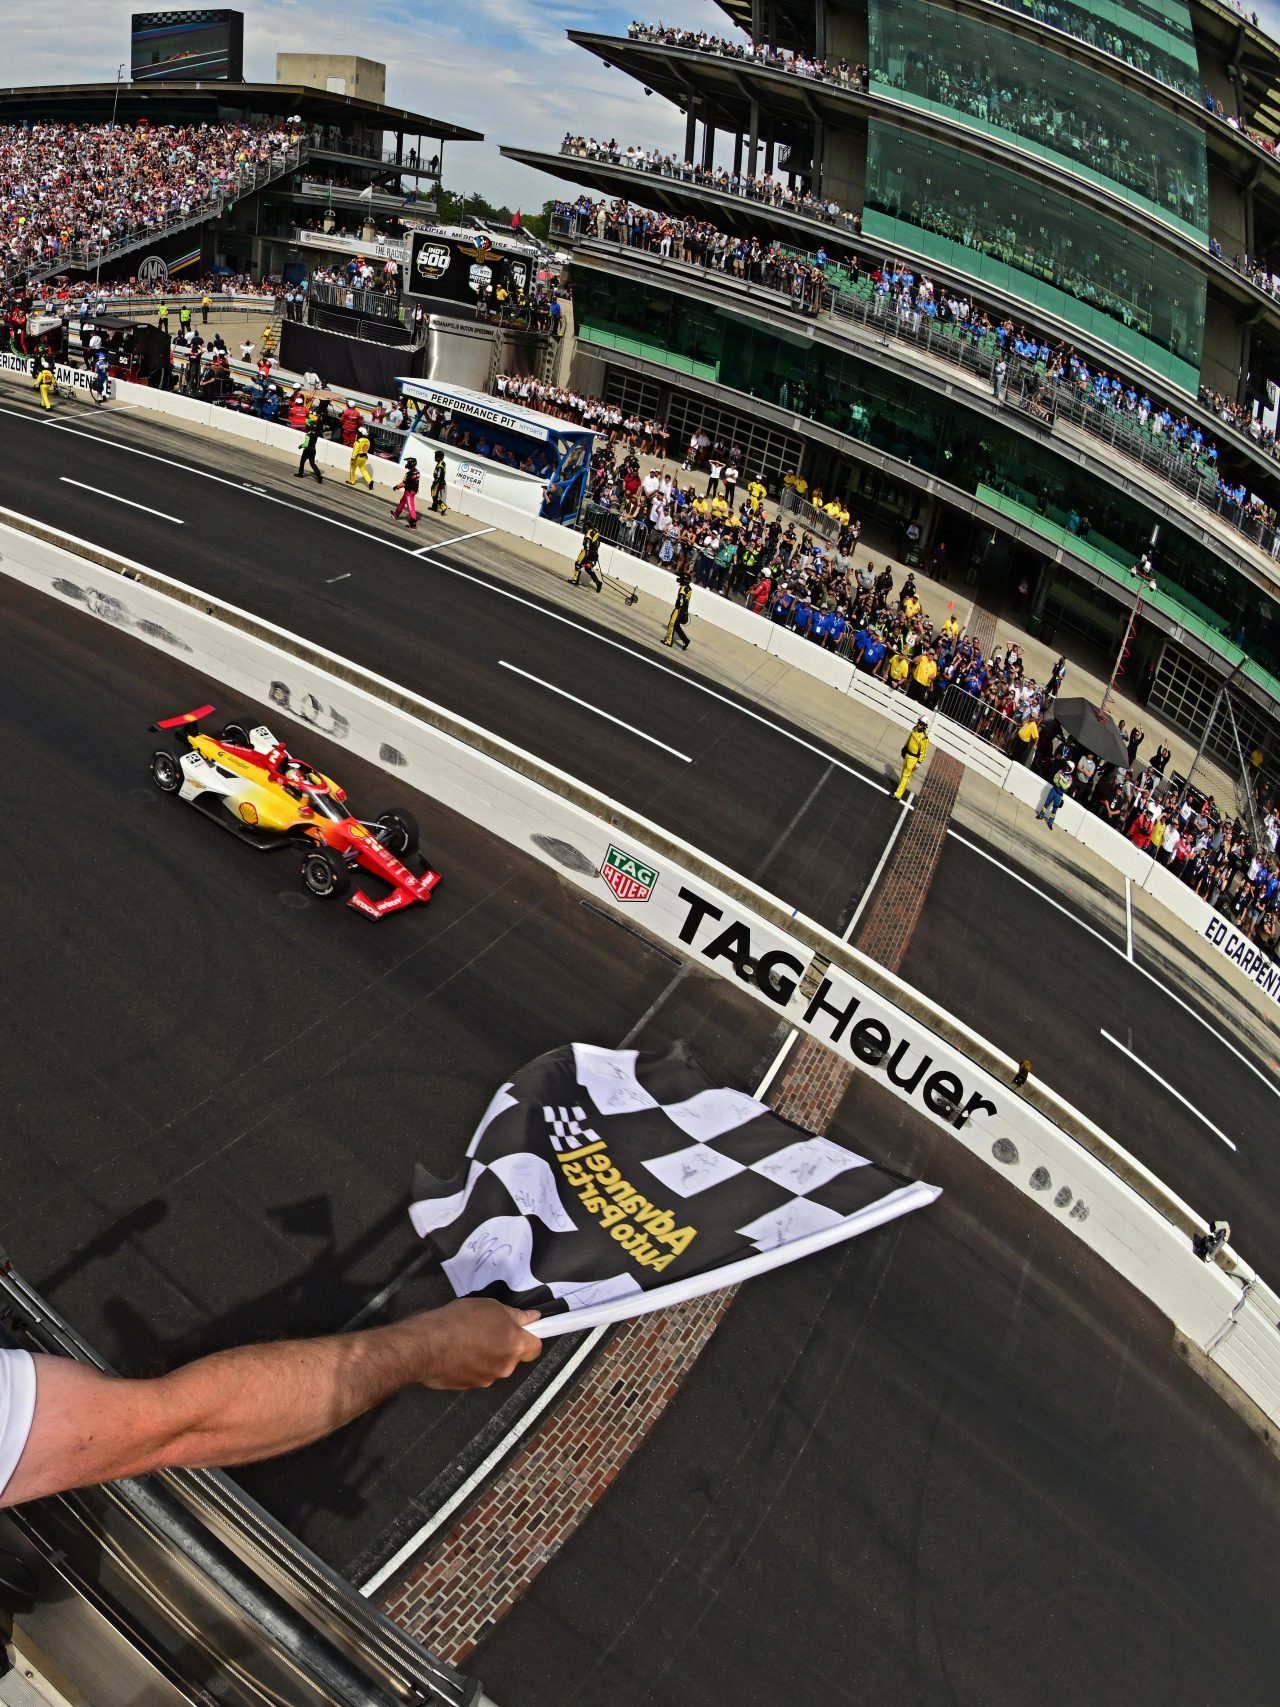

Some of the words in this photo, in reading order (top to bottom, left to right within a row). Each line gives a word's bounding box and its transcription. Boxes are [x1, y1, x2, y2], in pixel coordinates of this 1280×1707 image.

[375, 246, 385, 256] THE
[418, 251, 450, 269] 500
[428, 247, 445, 255] INDY
[73, 372, 111, 395] PENE
[431, 393, 499, 422] PERFORMANCE
[500, 416, 517, 428] PIT
[456, 472, 482, 485] INDYCAR
[470, 468, 482, 476] NTT
[269, 750, 280, 764] 2
[612, 850, 652, 885] TAG
[604, 864, 648, 898] HEUER
[1204, 916, 1228, 947] ED
[1224, 933, 1280, 1003] CARPENT
[677, 886, 805, 1007] TAG
[802, 977, 998, 1131] Heuer
